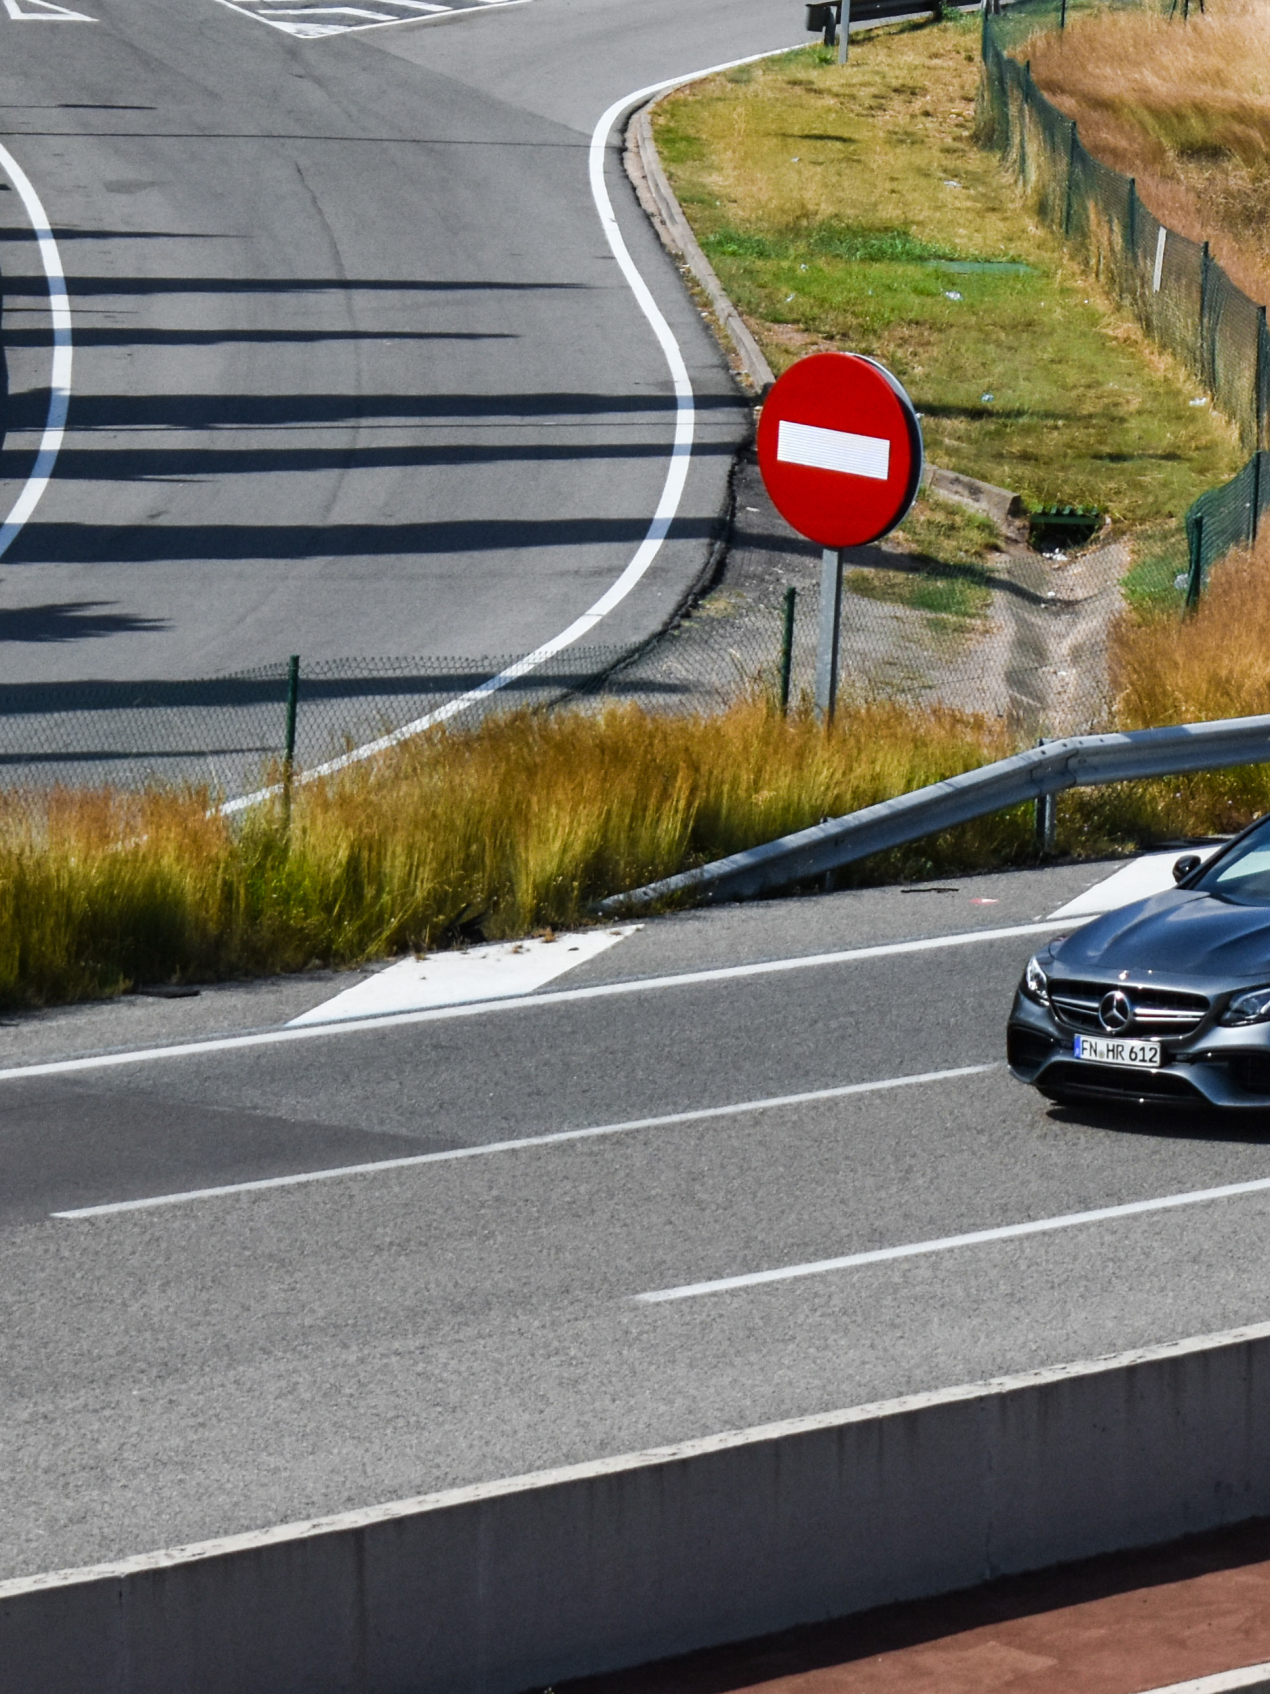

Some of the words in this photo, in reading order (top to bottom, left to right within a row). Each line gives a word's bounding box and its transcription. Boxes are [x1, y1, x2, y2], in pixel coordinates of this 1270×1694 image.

[1081, 1040, 1098, 1057] FN
[1106, 1043, 1125, 1061] HR
[1129, 1046, 1158, 1063] 612
